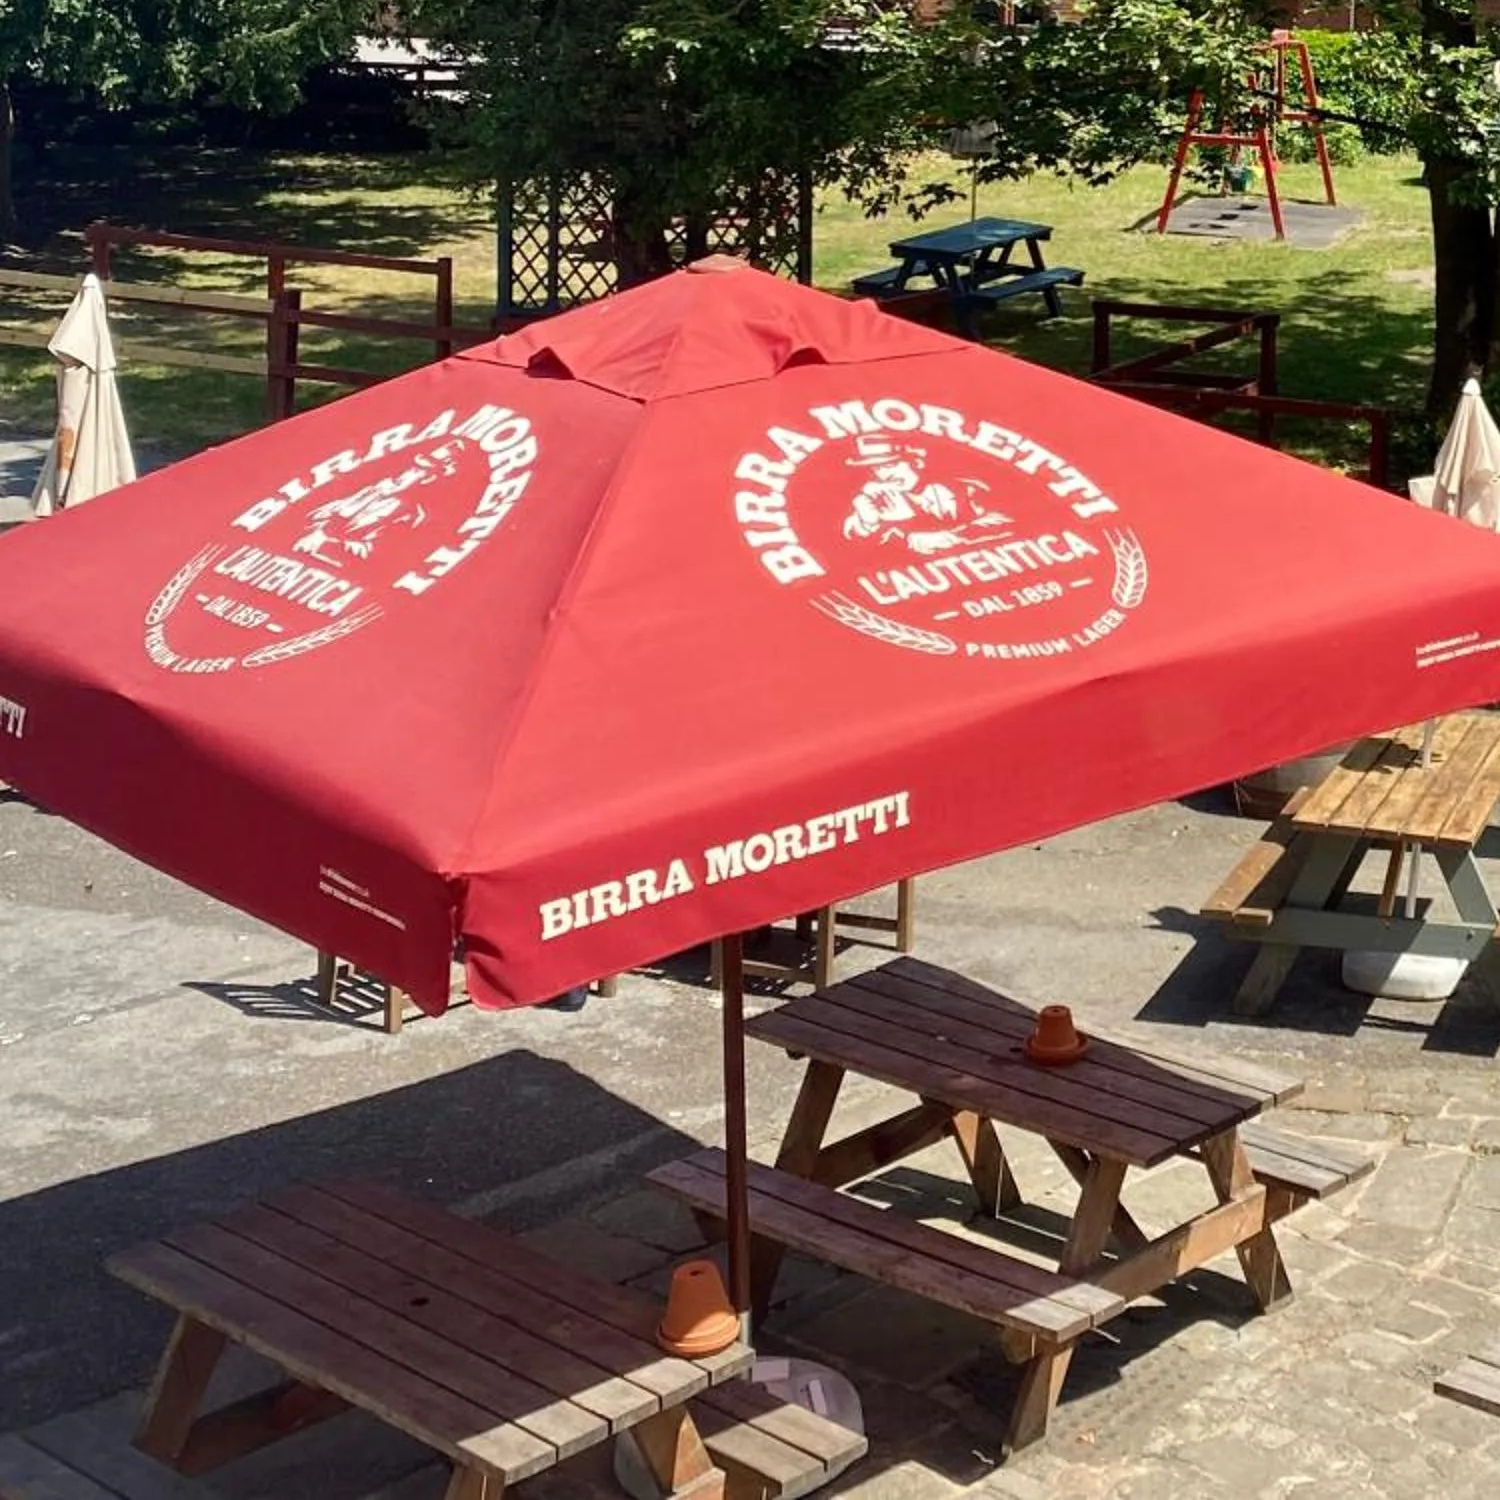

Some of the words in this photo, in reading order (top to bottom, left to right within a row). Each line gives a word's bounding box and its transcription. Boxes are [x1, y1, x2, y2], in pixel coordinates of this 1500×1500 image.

[231, 409, 457, 533] BIRRA
[392, 403, 539, 597] MORETTI
[734, 426, 826, 586] BIRRA
[809, 398, 1119, 519] MORETTI
[213, 545, 364, 618] L'AUTENTICA
[858, 530, 1100, 606] L'AUTENTICA
[962, 596, 1015, 619] DAL
[1011, 581, 1063, 607] 1859
[965, 638, 1073, 659] PREMIUM
[1072, 608, 1127, 646] LAGER
[539, 858, 695, 941] BIRRA
[704, 791, 911, 886] MORETTI
